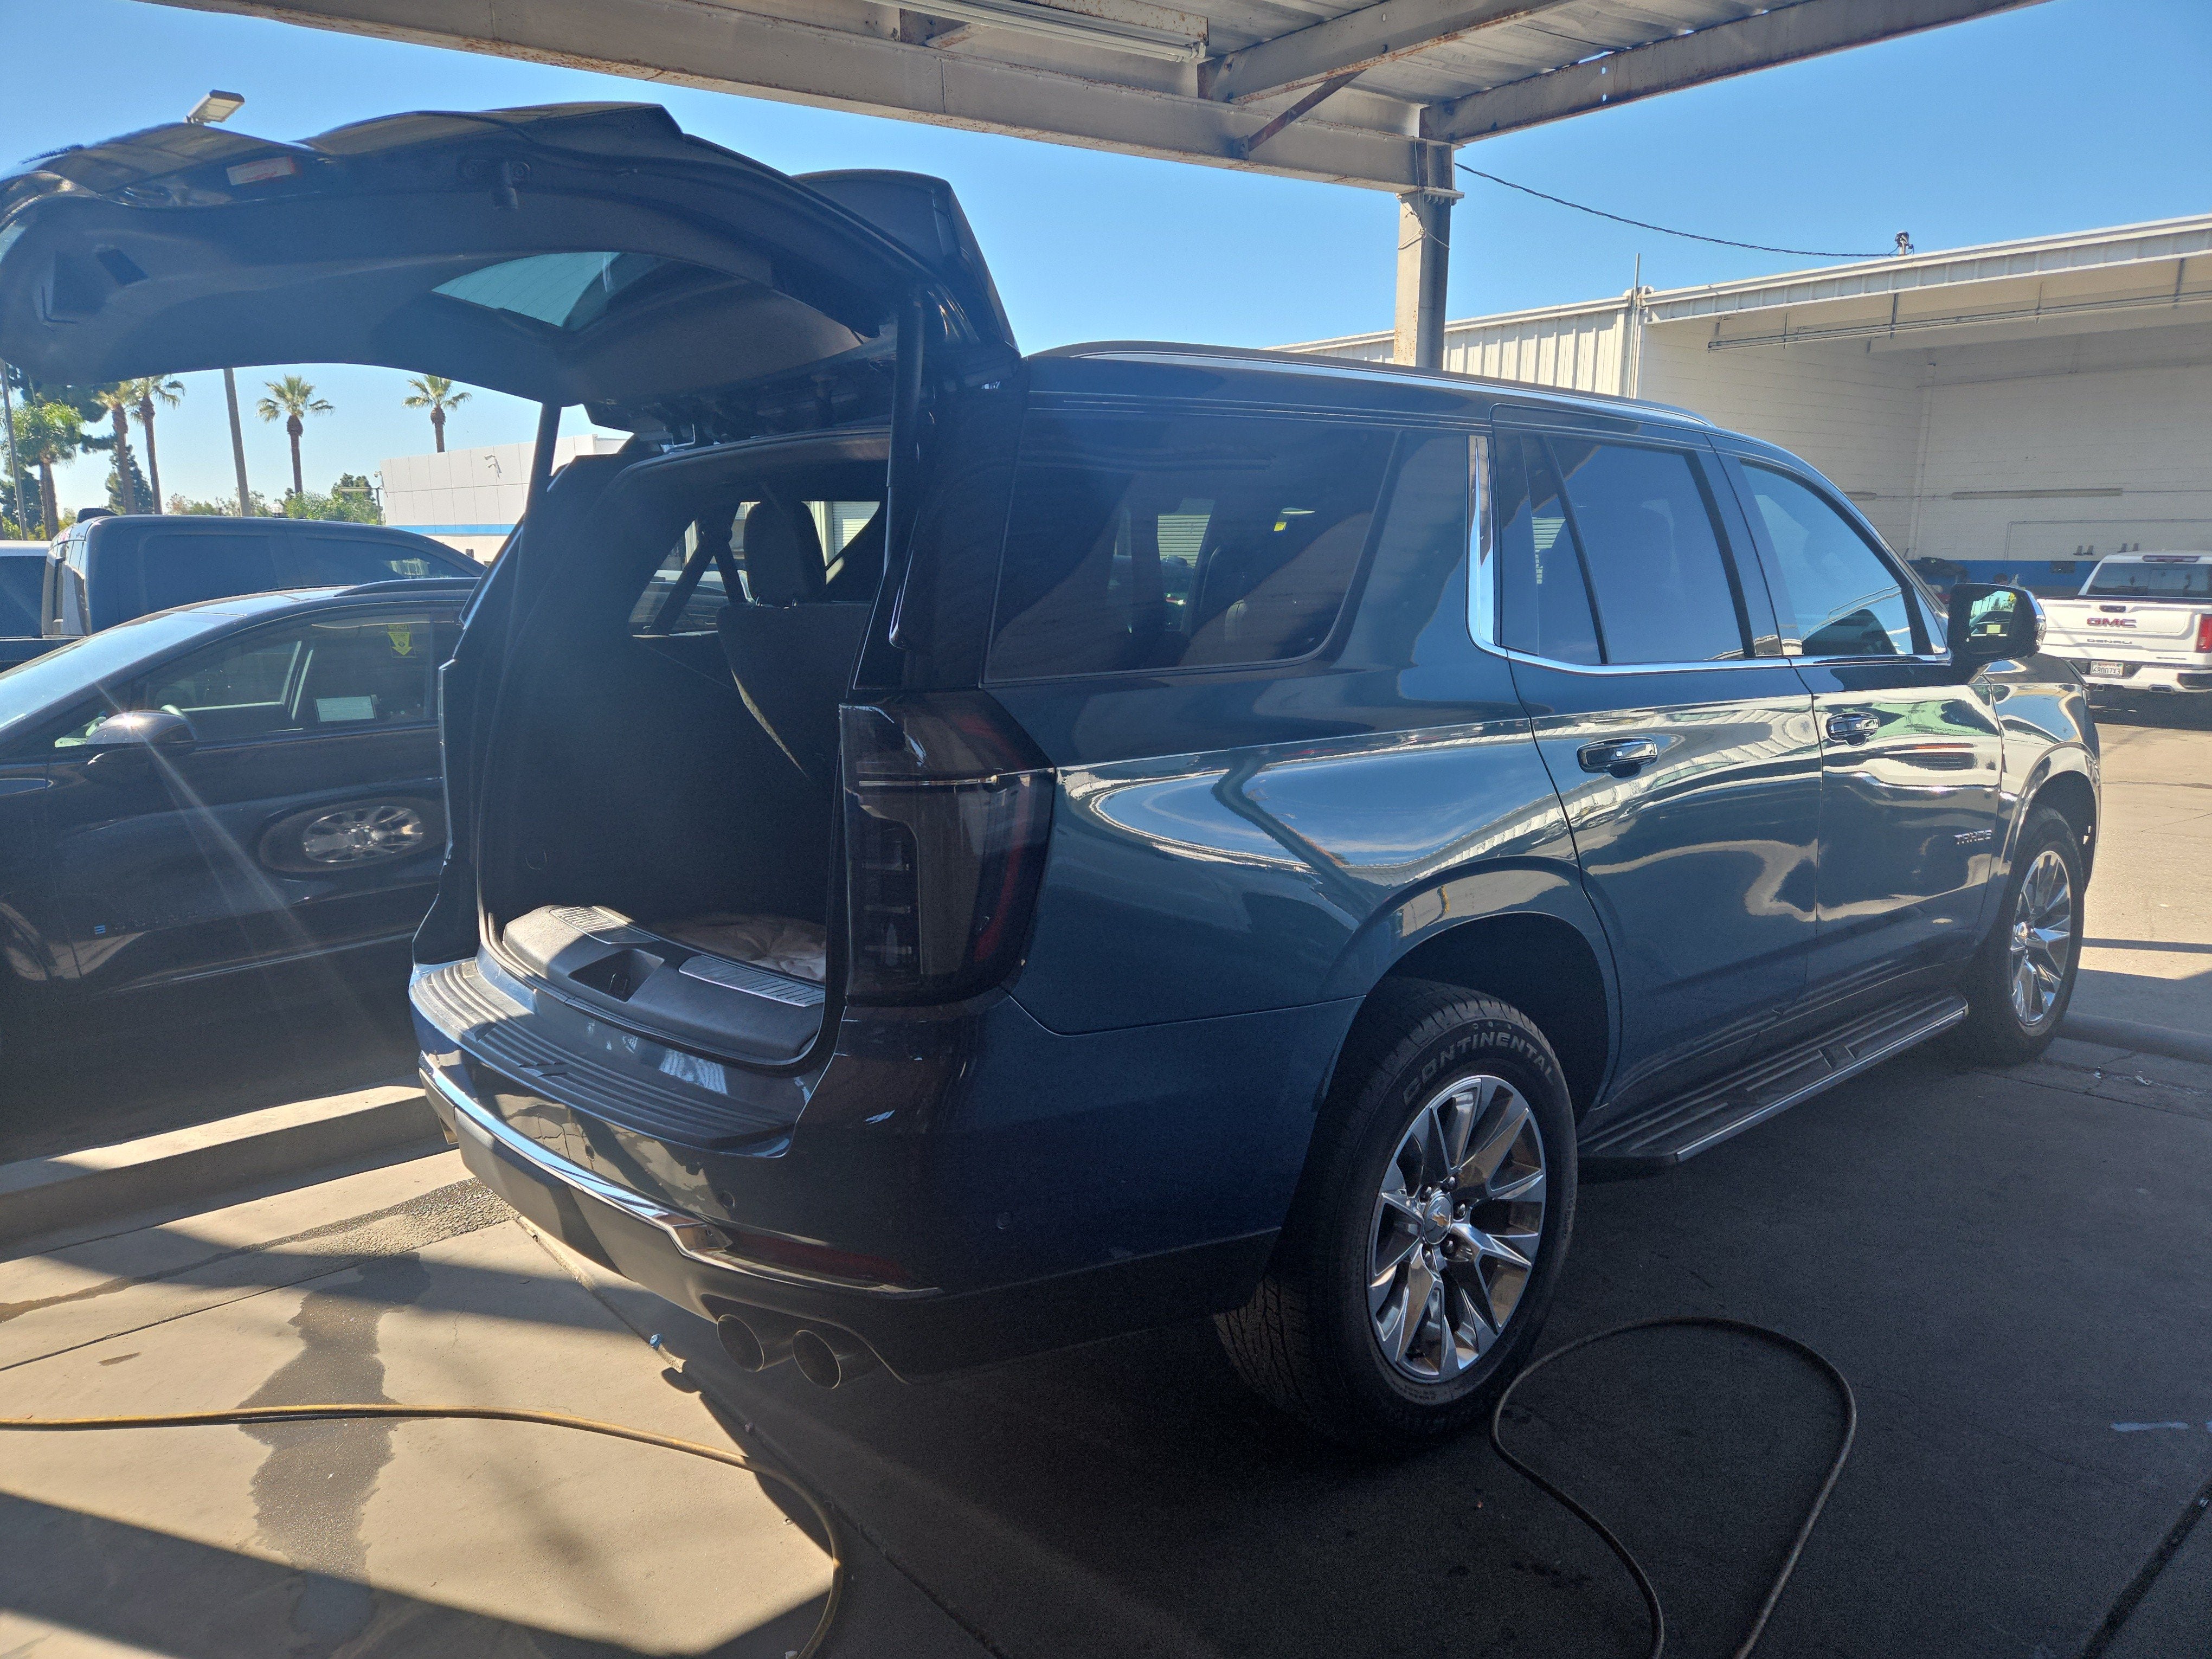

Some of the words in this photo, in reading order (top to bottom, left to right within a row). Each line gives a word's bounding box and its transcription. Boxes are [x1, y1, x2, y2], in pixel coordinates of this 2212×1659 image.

[2087, 618, 2136, 628] GMC
[1953, 829, 1992, 845] TAHOE
[1403, 1032, 1554, 1105] CONTINENTAL
